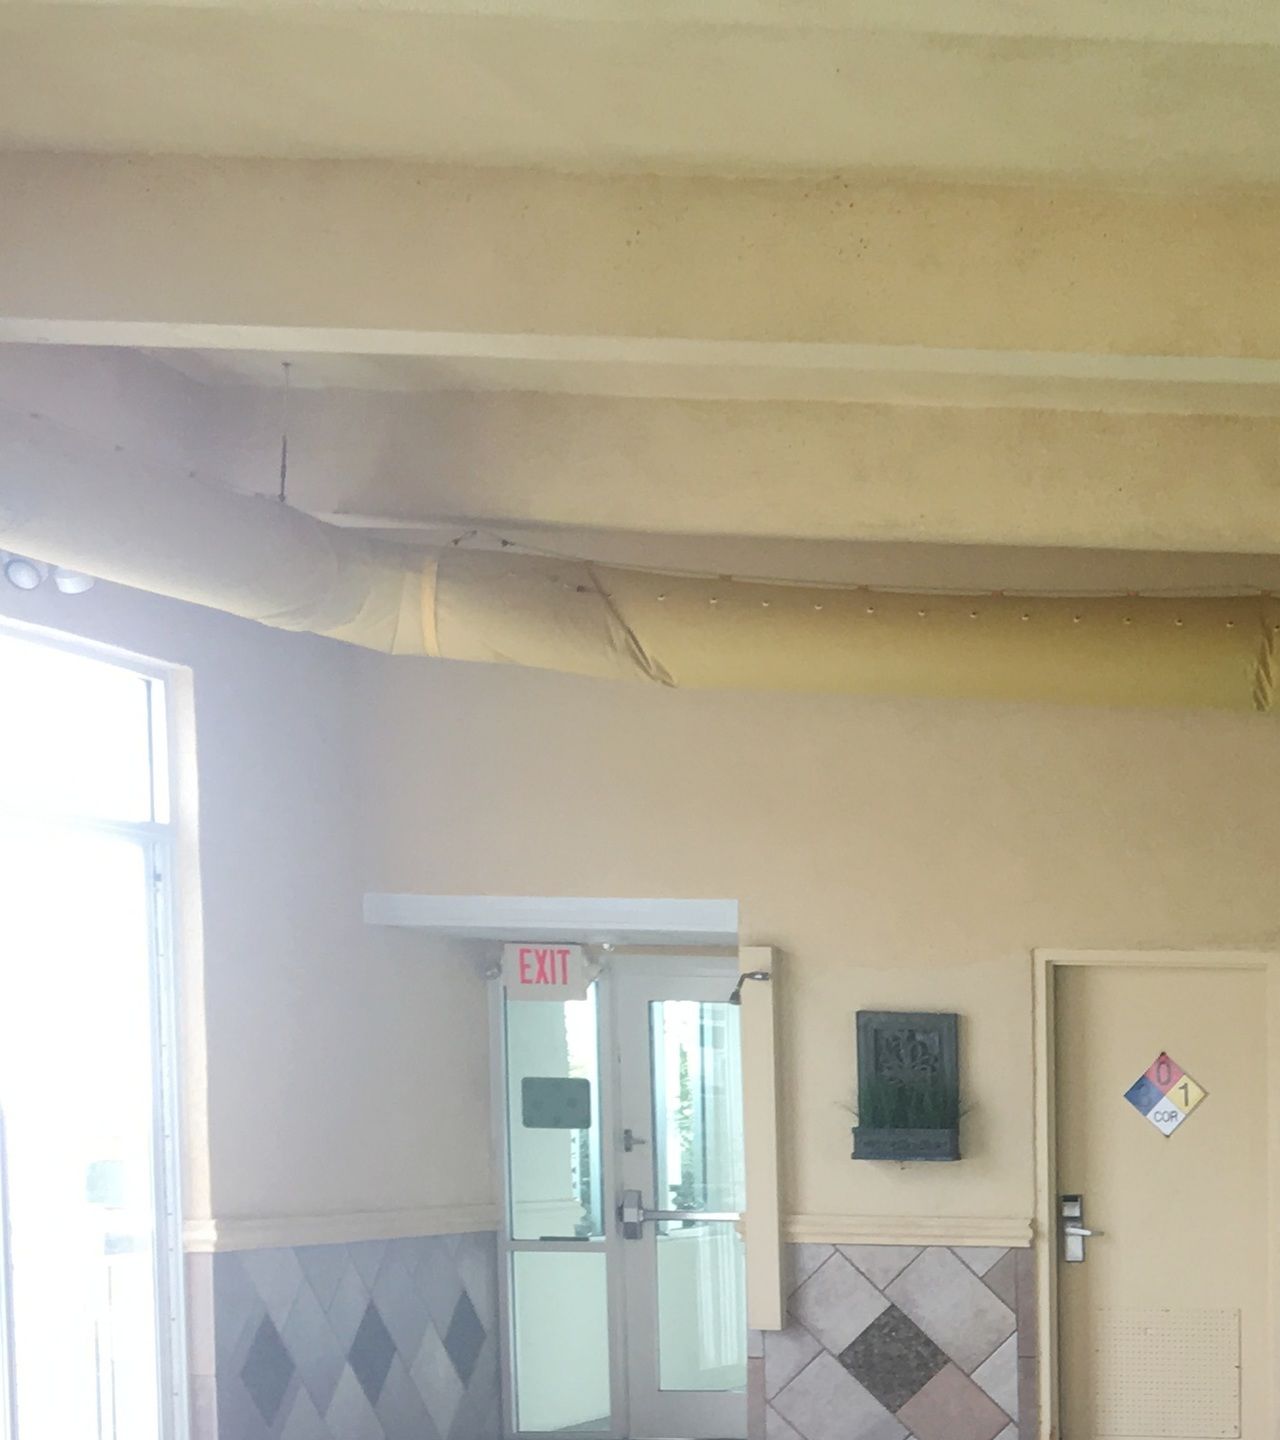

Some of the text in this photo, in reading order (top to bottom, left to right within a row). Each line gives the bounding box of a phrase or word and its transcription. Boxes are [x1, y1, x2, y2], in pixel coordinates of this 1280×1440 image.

[518, 948, 571, 985] EXIT
[1156, 1061, 1172, 1086] 0
[1178, 1082, 1189, 1107] 1
[1153, 1110, 1179, 1123] COR
